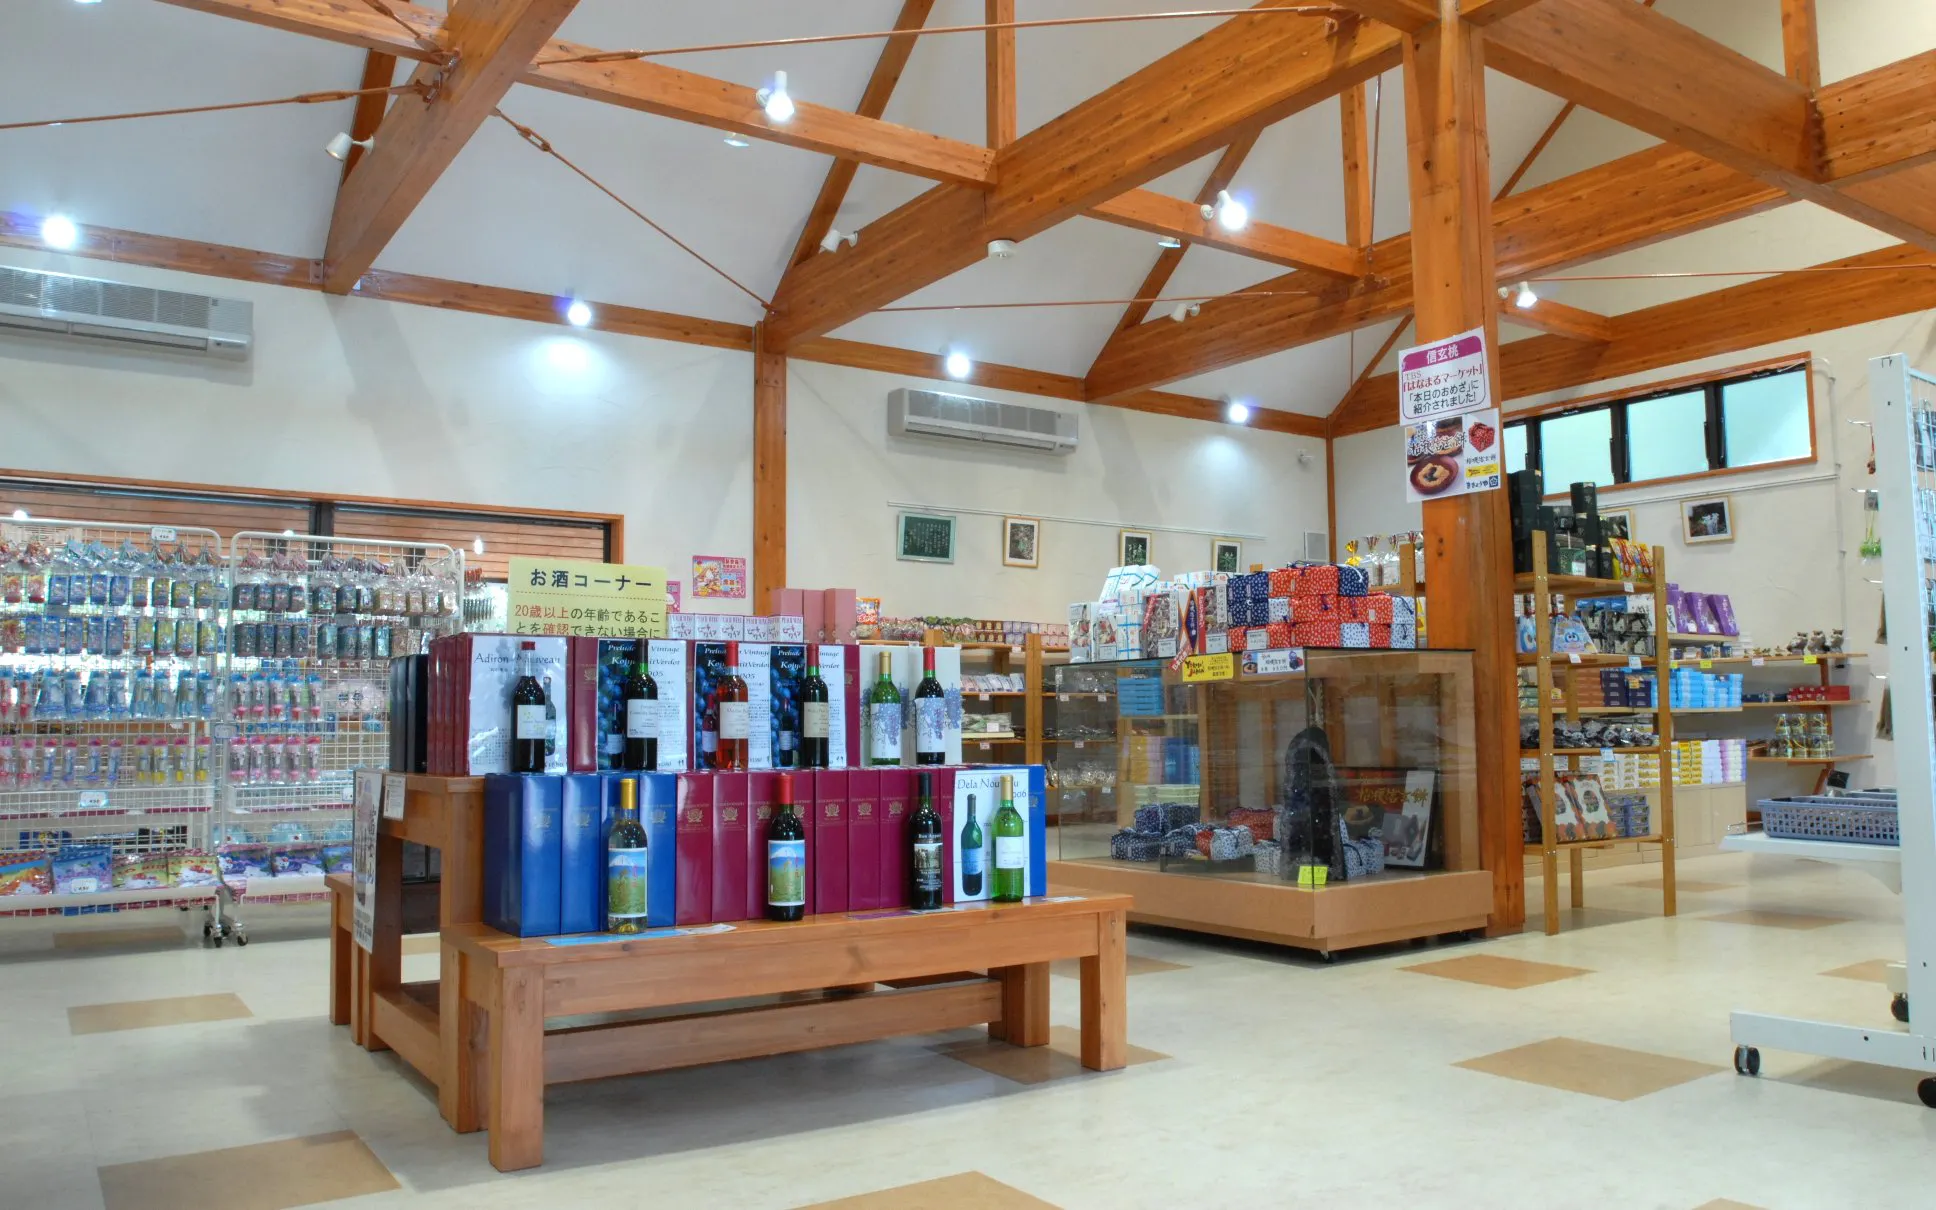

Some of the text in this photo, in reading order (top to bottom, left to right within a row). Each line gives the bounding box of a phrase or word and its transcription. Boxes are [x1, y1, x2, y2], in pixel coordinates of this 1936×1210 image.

[1426, 344, 1459, 364] 信玄桃
[1403, 364, 1482, 393] 「はなまるマーケット」
[1405, 371, 1422, 380] TBS
[1409, 380, 1479, 402] 「本日のおめざ」に
[530, 568, 652, 591] お酒コーナー
[514, 604, 660, 623] 20歳以上の年齢であるこ
[515, 621, 660, 637] とを確認できない場合に
[474, 653, 509, 664] Adiron
[819, 651, 839, 659] intage
[957, 778, 1019, 789] Dela Nouu
